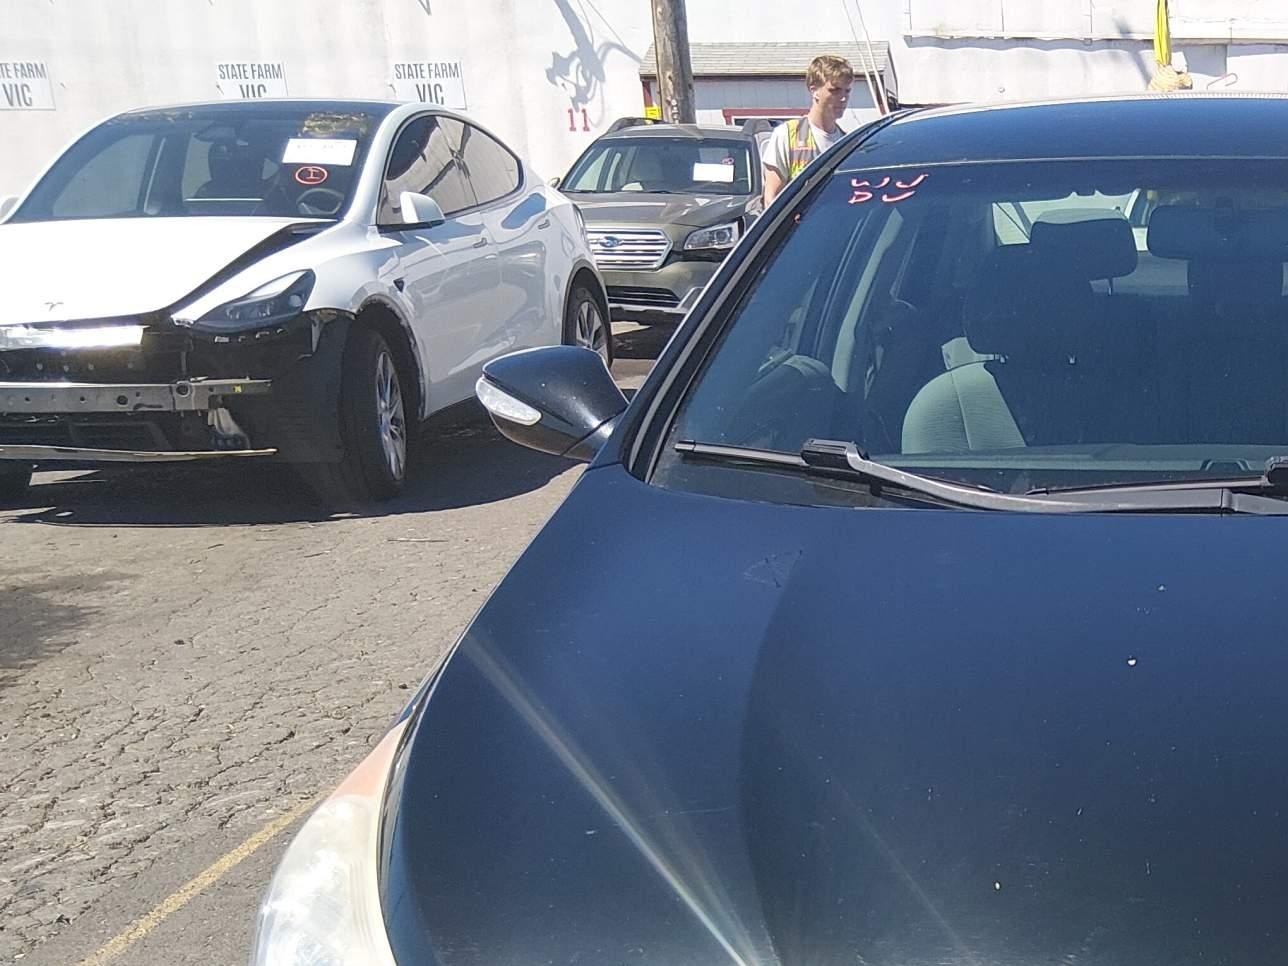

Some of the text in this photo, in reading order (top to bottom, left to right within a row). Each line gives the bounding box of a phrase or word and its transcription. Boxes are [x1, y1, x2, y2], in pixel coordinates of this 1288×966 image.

[13, 62, 47, 79] FARM
[218, 63, 282, 80] STATE FARM
[394, 62, 460, 80] STATE FARM
[2, 83, 33, 107] VIC
[415, 83, 444, 105] VIC
[567, 108, 590, 131] 11
